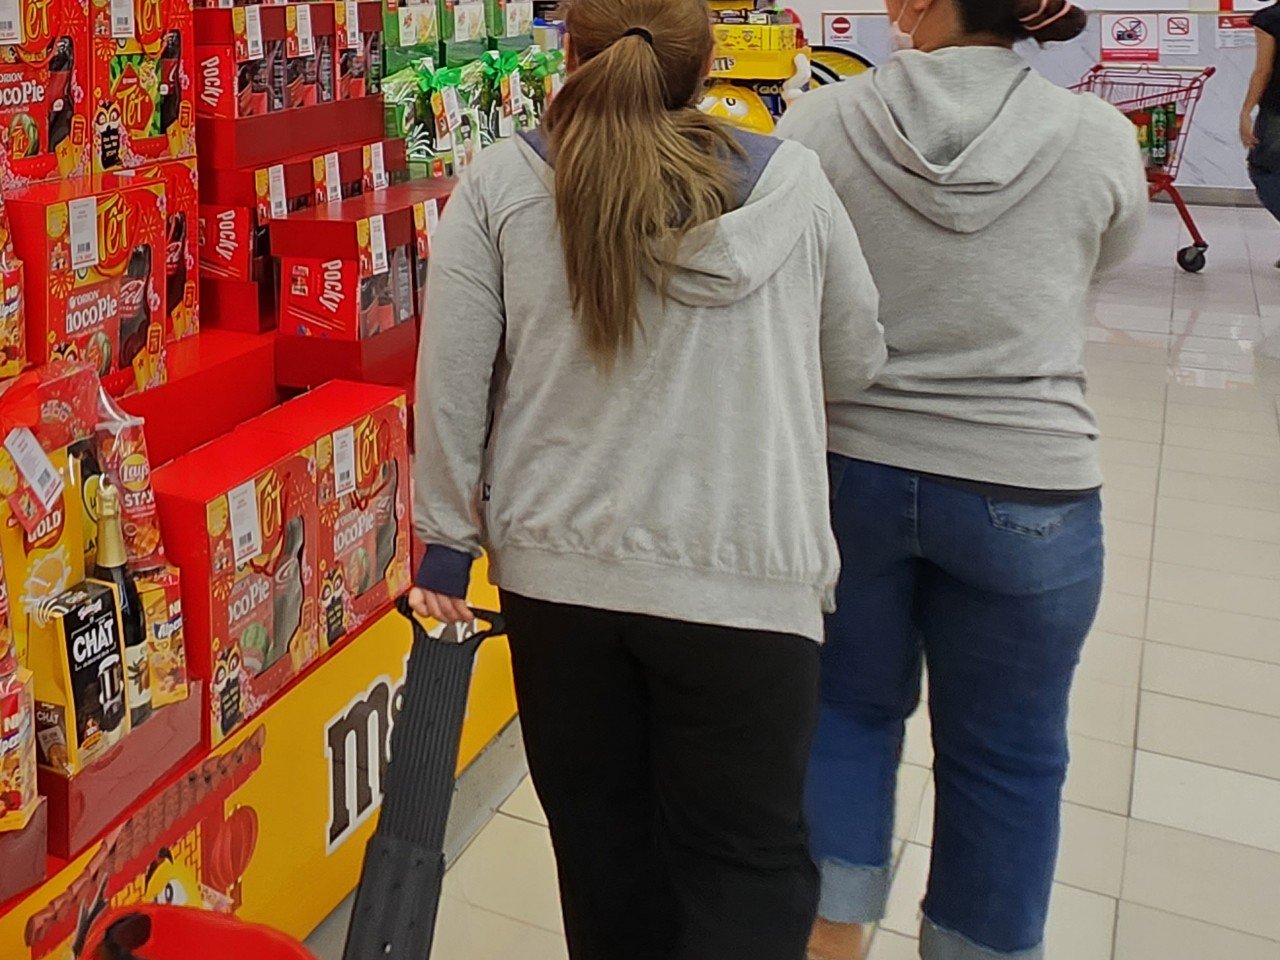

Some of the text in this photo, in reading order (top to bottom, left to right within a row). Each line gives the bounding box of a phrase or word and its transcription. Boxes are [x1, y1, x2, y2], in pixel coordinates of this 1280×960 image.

[114, 88, 143, 126] Tết
[97, 193, 132, 262] Tết
[66, 296, 118, 335] hocoPie
[123, 492, 155, 508] STAX
[73, 617, 115, 662] CHẤT
